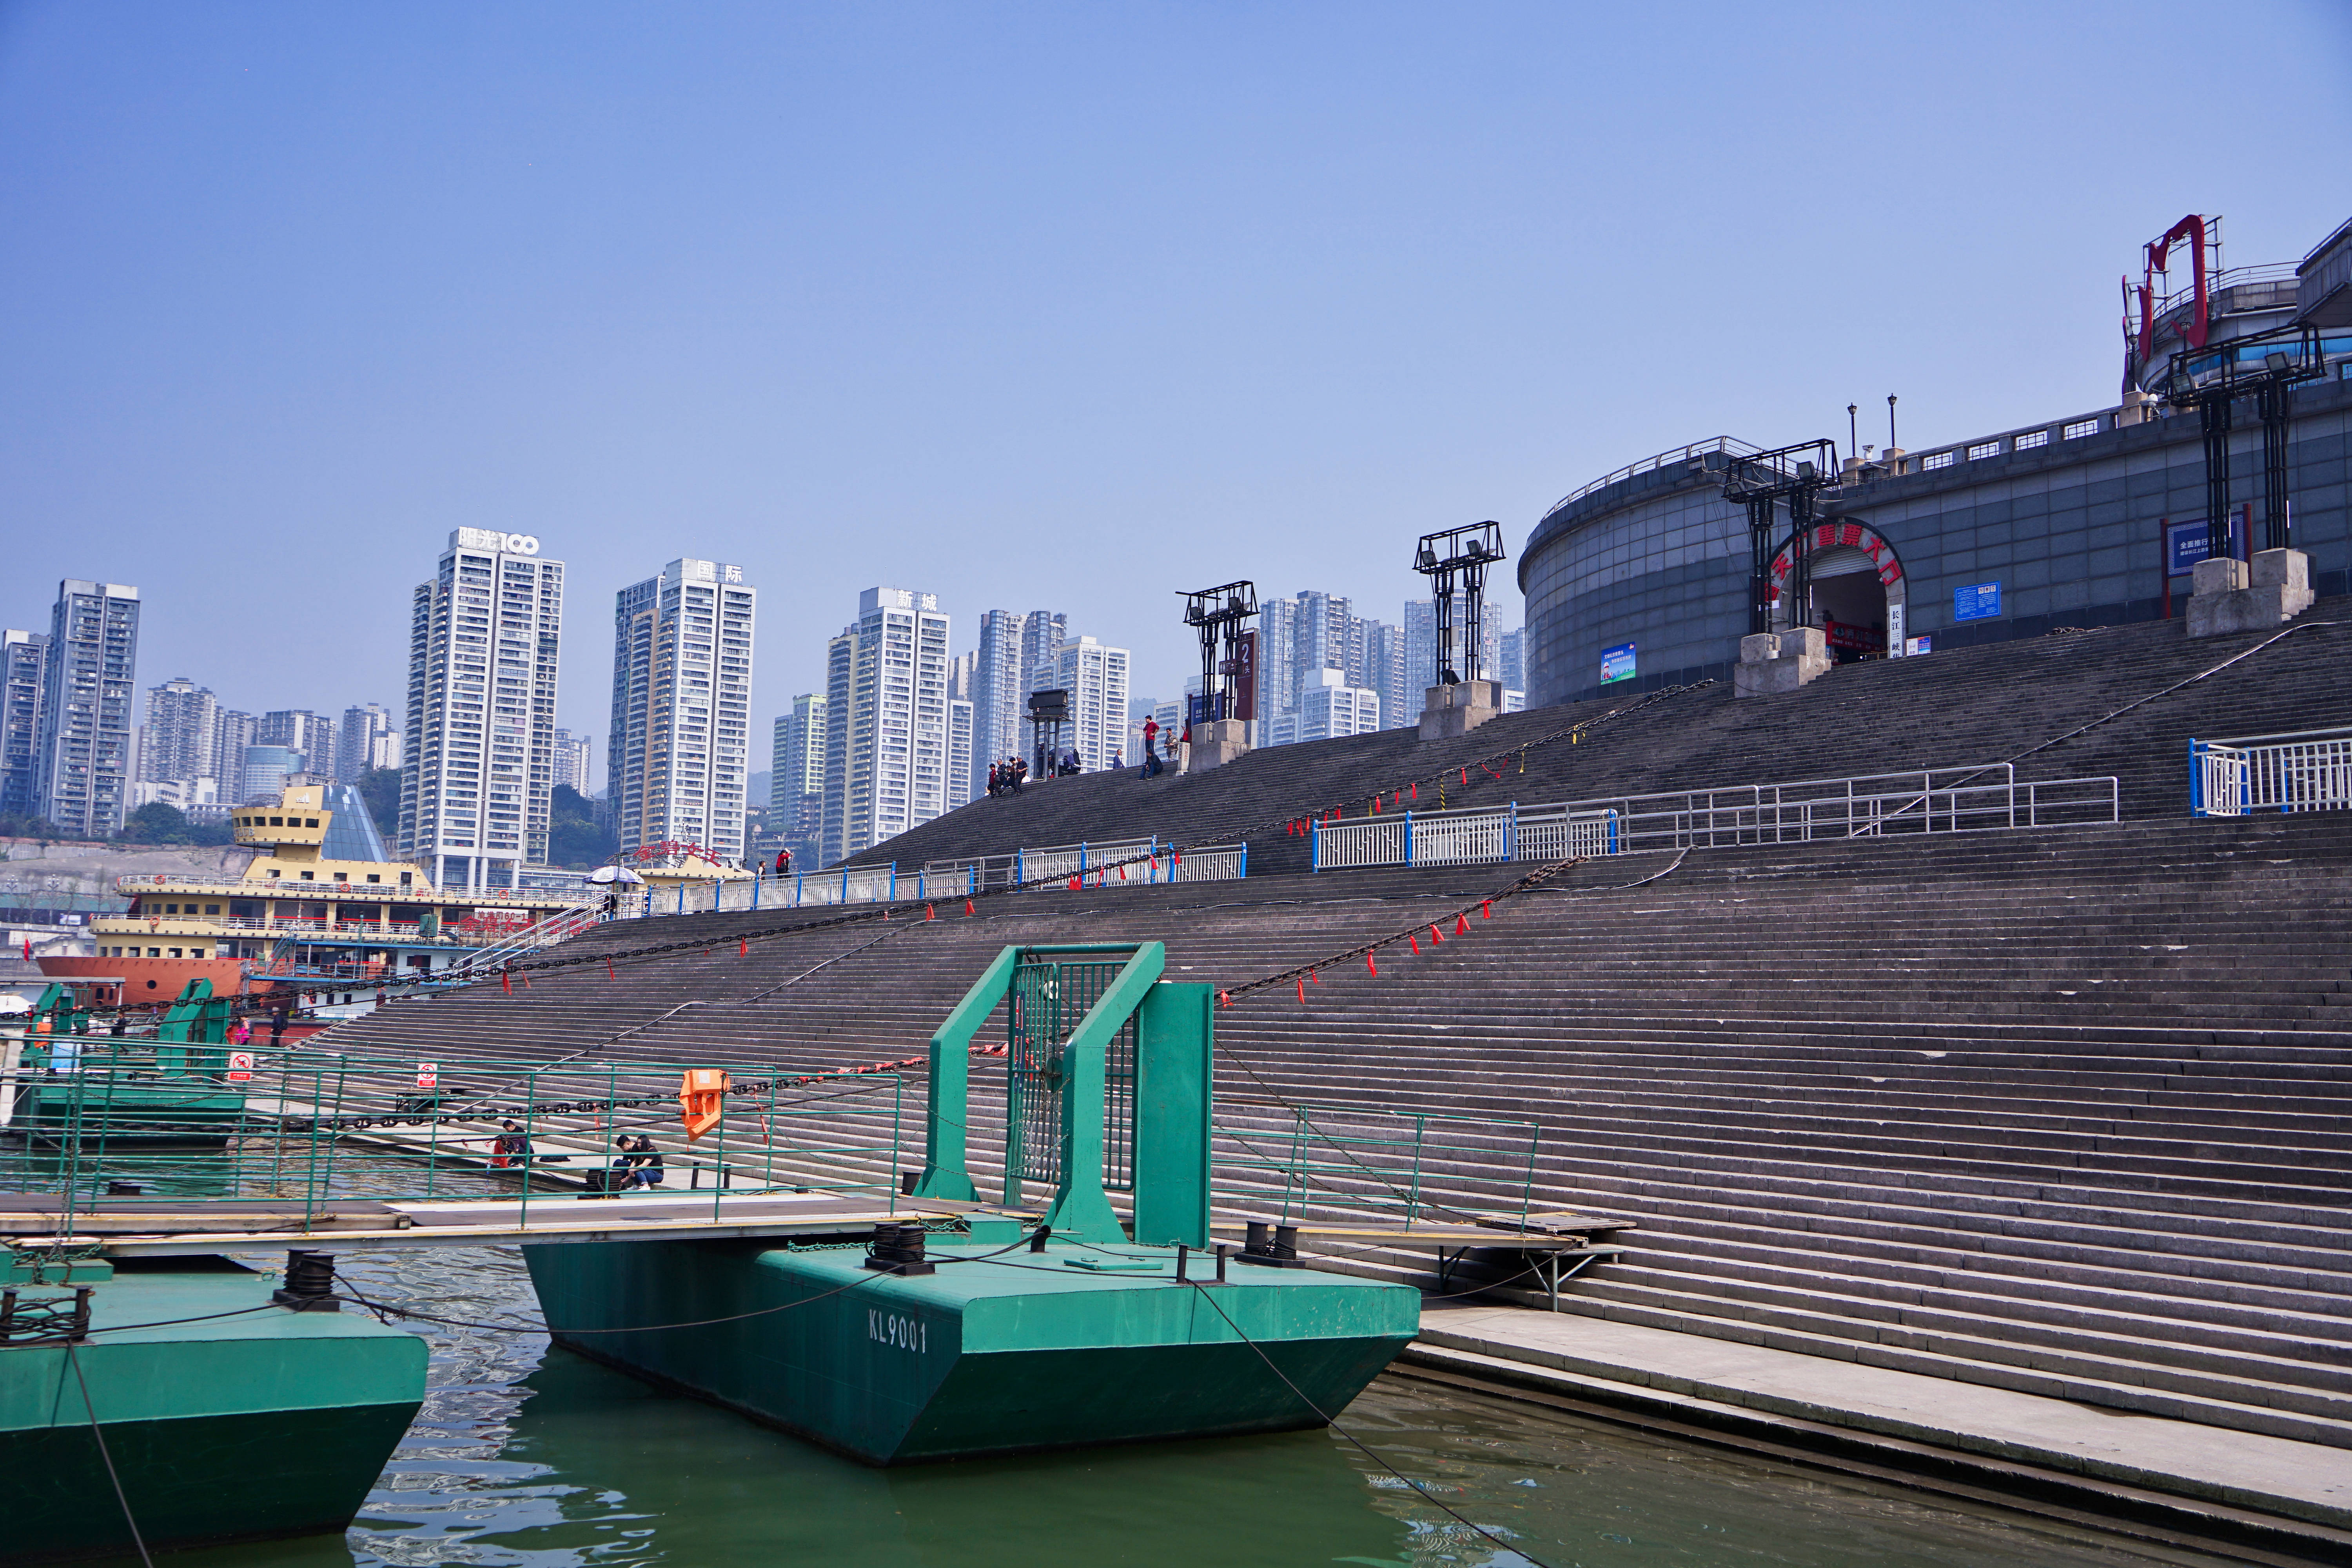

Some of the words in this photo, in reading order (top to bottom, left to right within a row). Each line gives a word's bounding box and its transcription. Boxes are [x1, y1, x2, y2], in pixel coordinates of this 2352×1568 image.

[459, 526, 539, 555] 阳光100
[698, 560, 742, 583] 国际
[897, 590, 937, 612] 新城
[1242, 644, 1249, 663] 2
[633, 839, 722, 867] 金碧女王
[869, 1309, 925, 1354] KL9001
